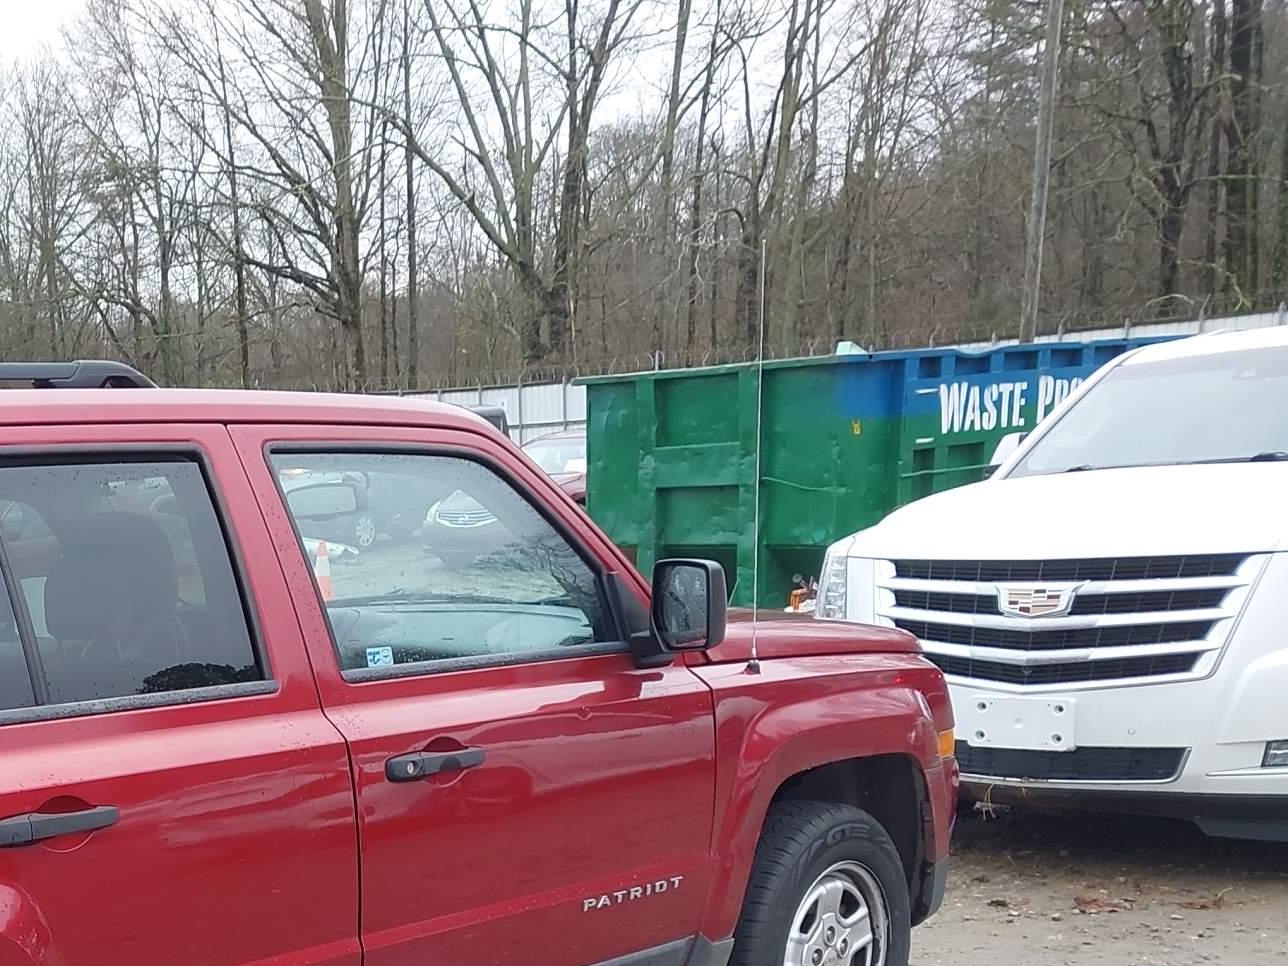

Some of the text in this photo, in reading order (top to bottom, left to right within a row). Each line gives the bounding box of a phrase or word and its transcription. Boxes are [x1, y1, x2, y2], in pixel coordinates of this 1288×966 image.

[940, 375, 1083, 434] WASTE PR
[582, 876, 683, 912] PATRIOT
